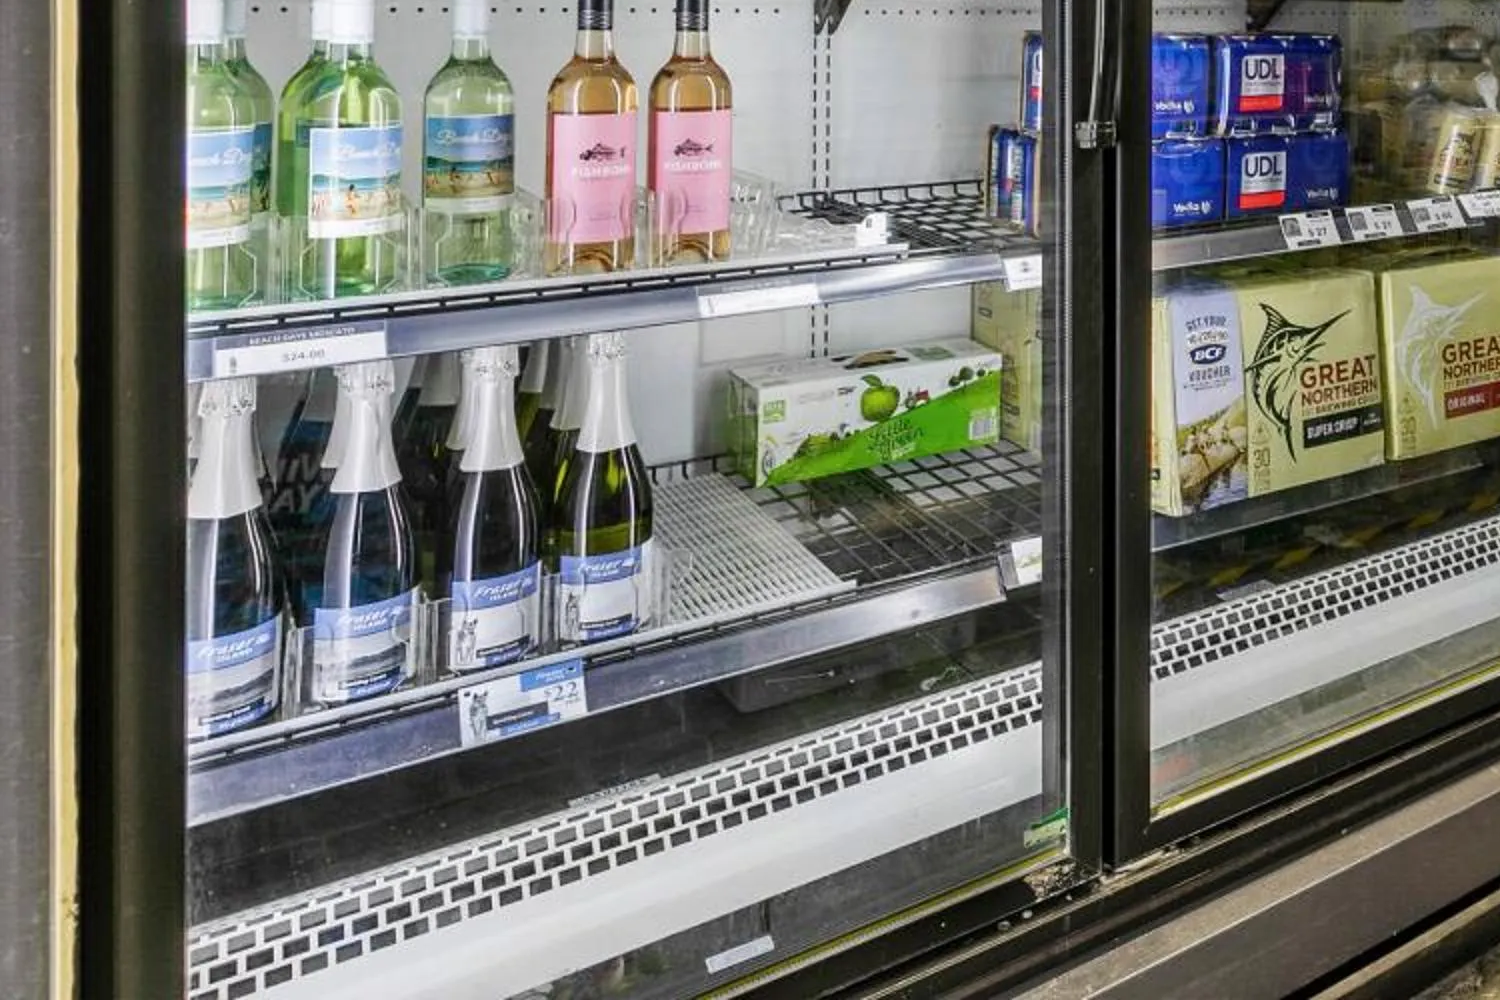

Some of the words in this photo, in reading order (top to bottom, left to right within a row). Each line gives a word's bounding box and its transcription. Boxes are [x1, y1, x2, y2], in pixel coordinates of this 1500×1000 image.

[1244, 57, 1283, 80] UDL
[1244, 155, 1283, 178] UDL
[1299, 354, 1377, 389] GREAT
[1301, 378, 1378, 407] NORTHERN
[1253, 447, 1271, 470] 30
